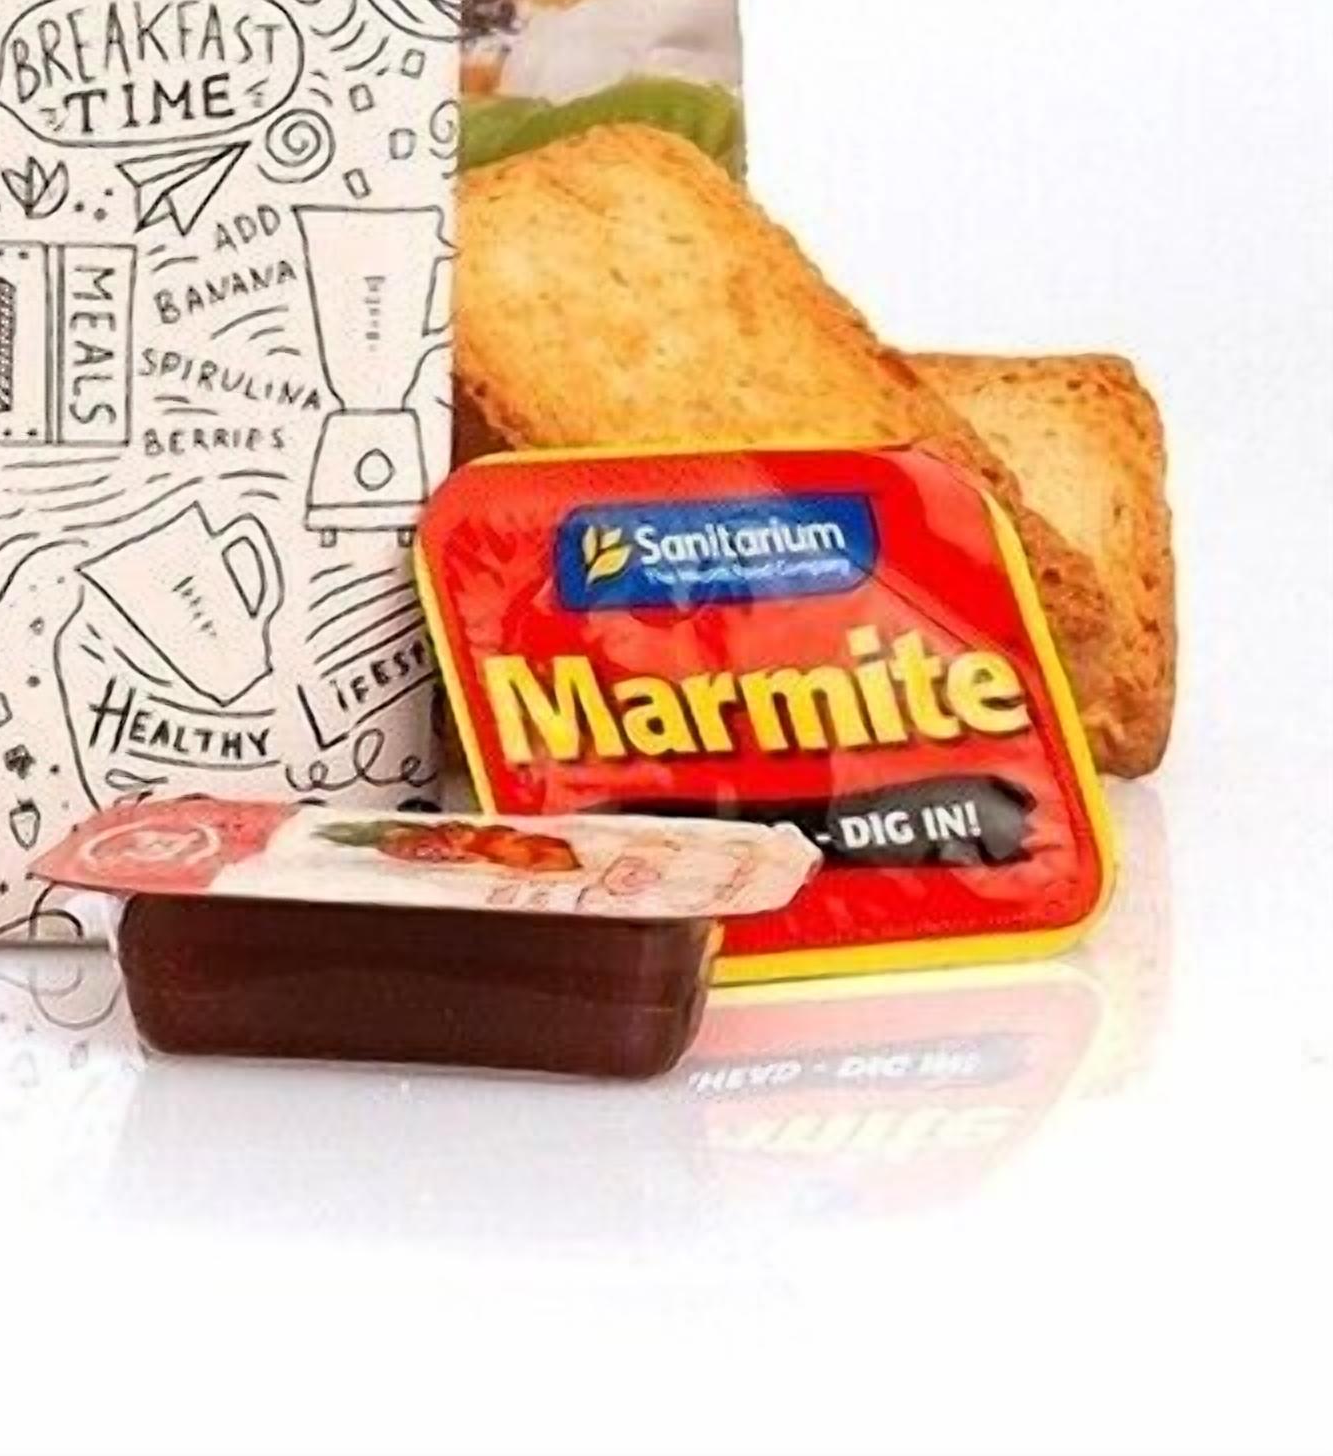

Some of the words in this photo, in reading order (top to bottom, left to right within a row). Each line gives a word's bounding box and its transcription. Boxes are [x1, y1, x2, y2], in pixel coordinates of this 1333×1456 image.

[12, 0, 284, 103] BREAKFAST
[61, 72, 236, 136] TIME
[214, 204, 281, 253] ADD
[154, 260, 298, 325] BANANA
[68, 265, 118, 425] MEALS
[138, 347, 322, 411] SPIRULINA
[143, 427, 286, 457] BERRIES
[635, 516, 846, 566] Sanitarium
[88, 676, 272, 760] HEALTHY
[483, 624, 1031, 765] Marmite
[838, 809, 916, 850] DIG
[920, 799, 983, 841] IN!
